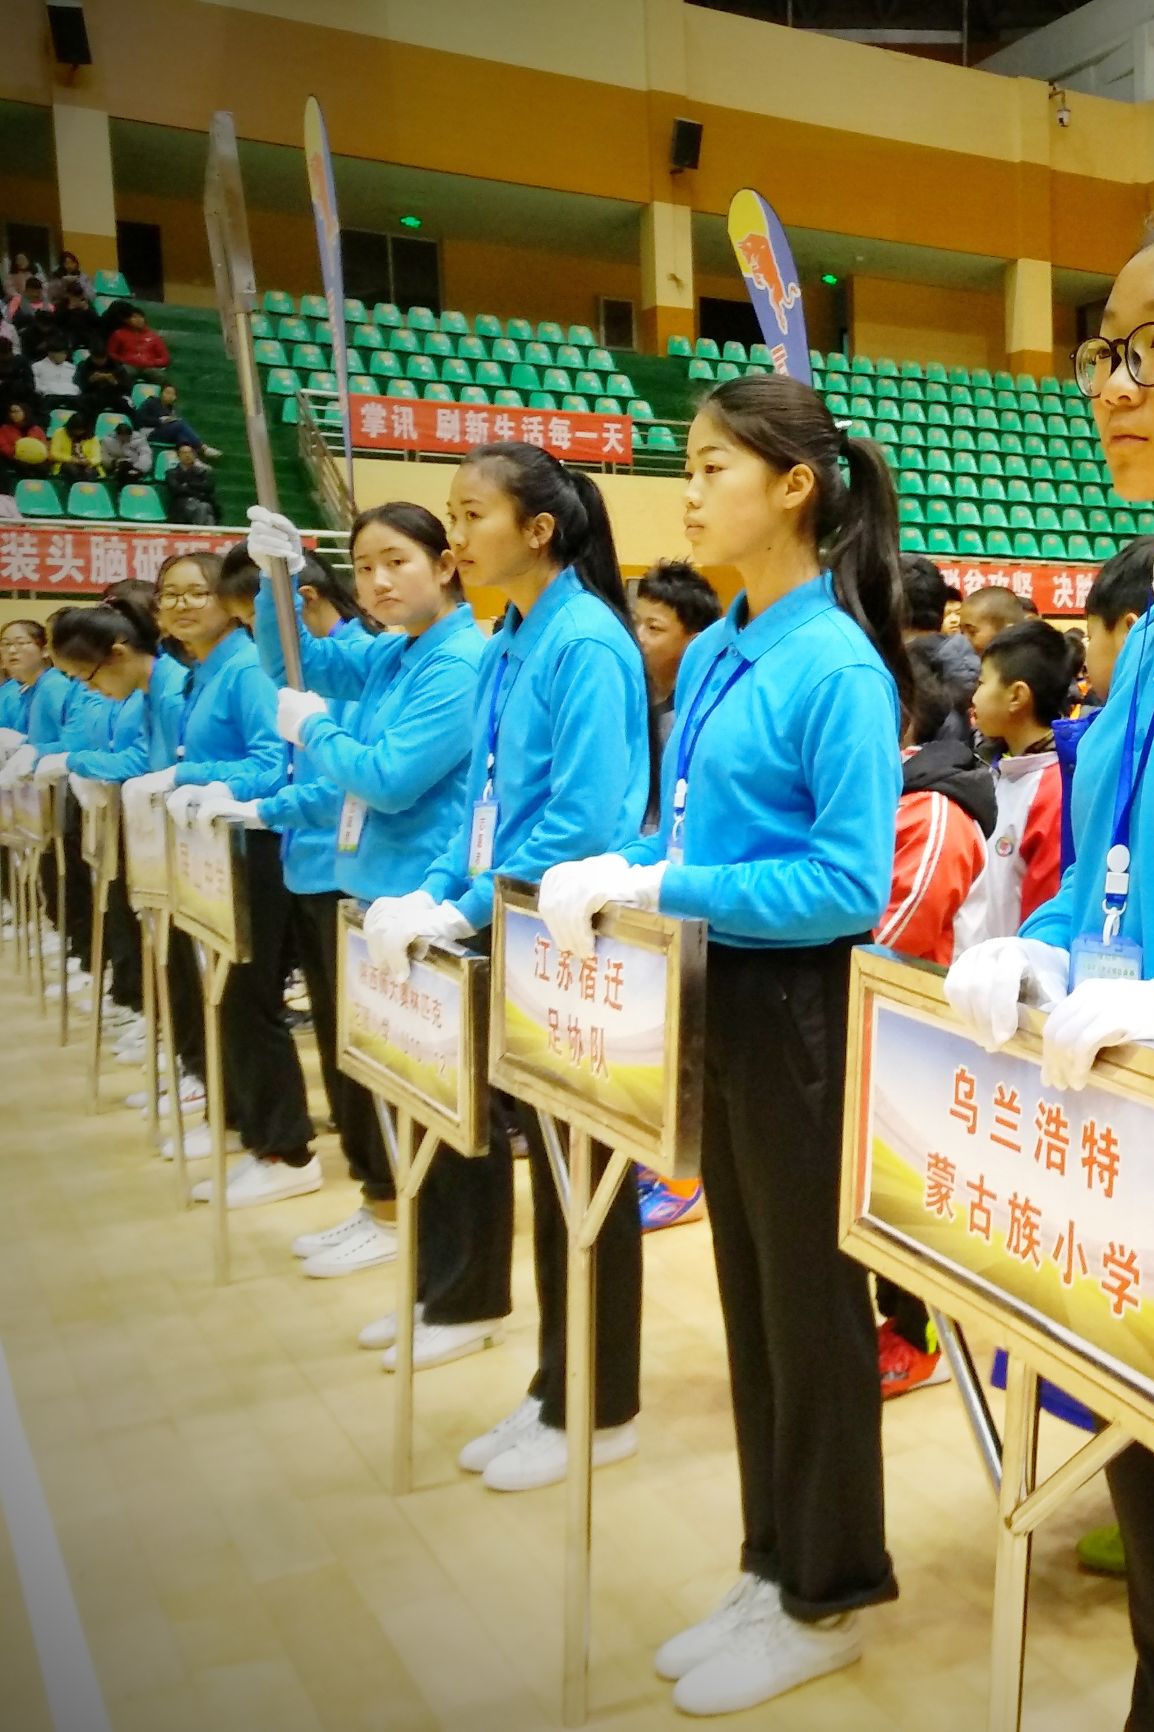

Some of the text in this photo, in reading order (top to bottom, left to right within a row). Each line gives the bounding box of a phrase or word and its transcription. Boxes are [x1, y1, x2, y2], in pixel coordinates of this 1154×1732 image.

[360, 401, 625, 455] 掌讯 刷新生活每一天
[534, 933, 624, 1012] 江苏宿迁
[548, 1007, 609, 1078] 足协队
[949, 1066, 1121, 1199] 乌兰浩特
[924, 1151, 1141, 1316] 蒙古族小学
